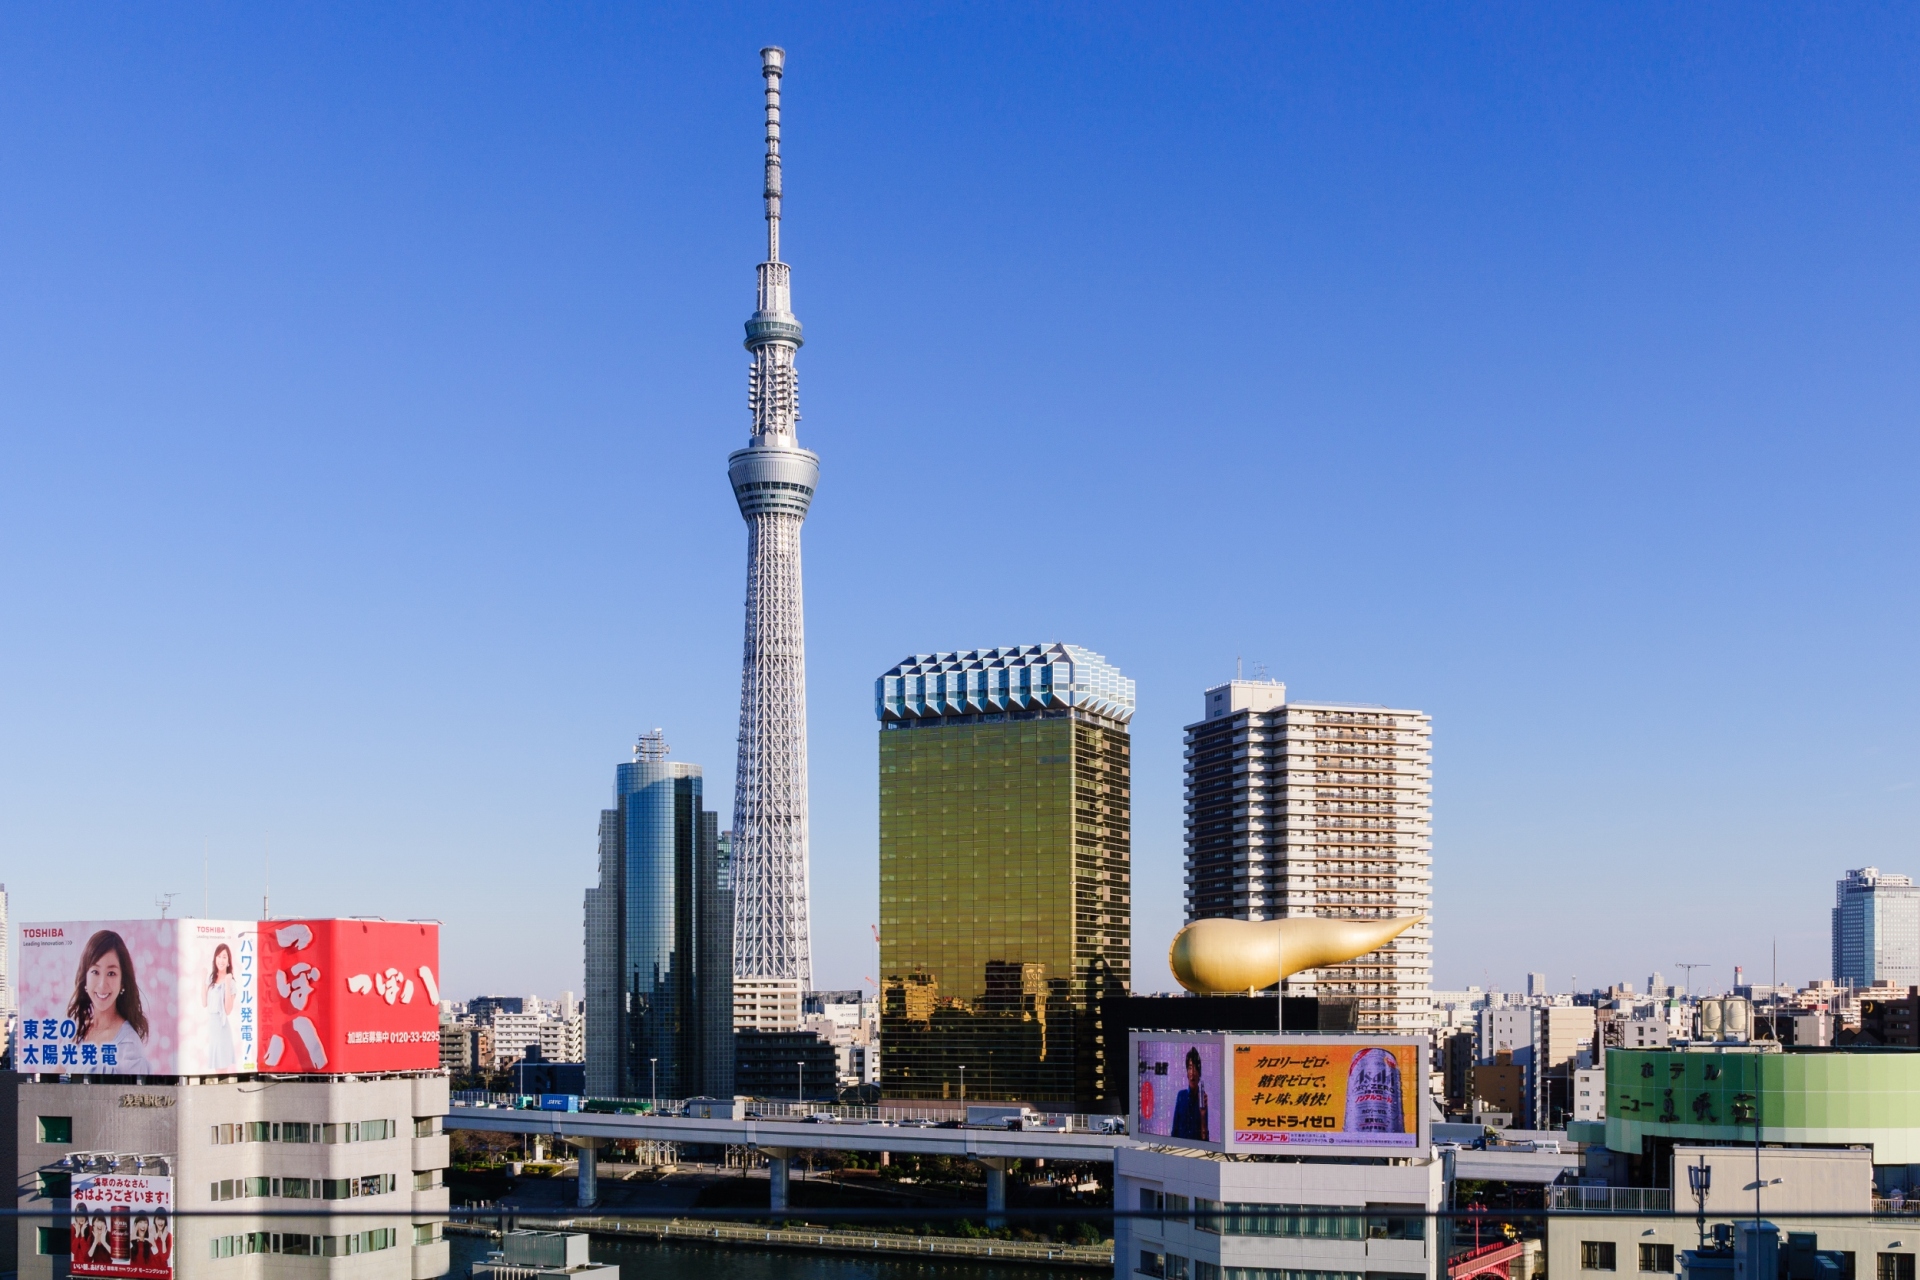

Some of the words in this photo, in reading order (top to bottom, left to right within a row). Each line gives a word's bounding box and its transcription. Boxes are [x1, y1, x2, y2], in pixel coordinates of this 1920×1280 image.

[23, 928, 64, 938] TOSHIBA
[347, 965, 440, 1006] つぼ八
[264, 924, 328, 1069] つぼ八
[23, 1019, 76, 1040] 東芝の
[390, 1031, 441, 1043] 0120-33-9295
[23, 1044, 118, 1066] 太陽光発電
[1354, 1069, 1395, 1087] Asahi
[1641, 1062, 1721, 1080] ホテル
[1371, 1084, 1395, 1093] ZERO
[1247, 1115, 1335, 1128] アサヒドライゼロ
[1238, 1133, 1288, 1142] ノンアルコール
[74, 1188, 169, 1204] おはようございます!
